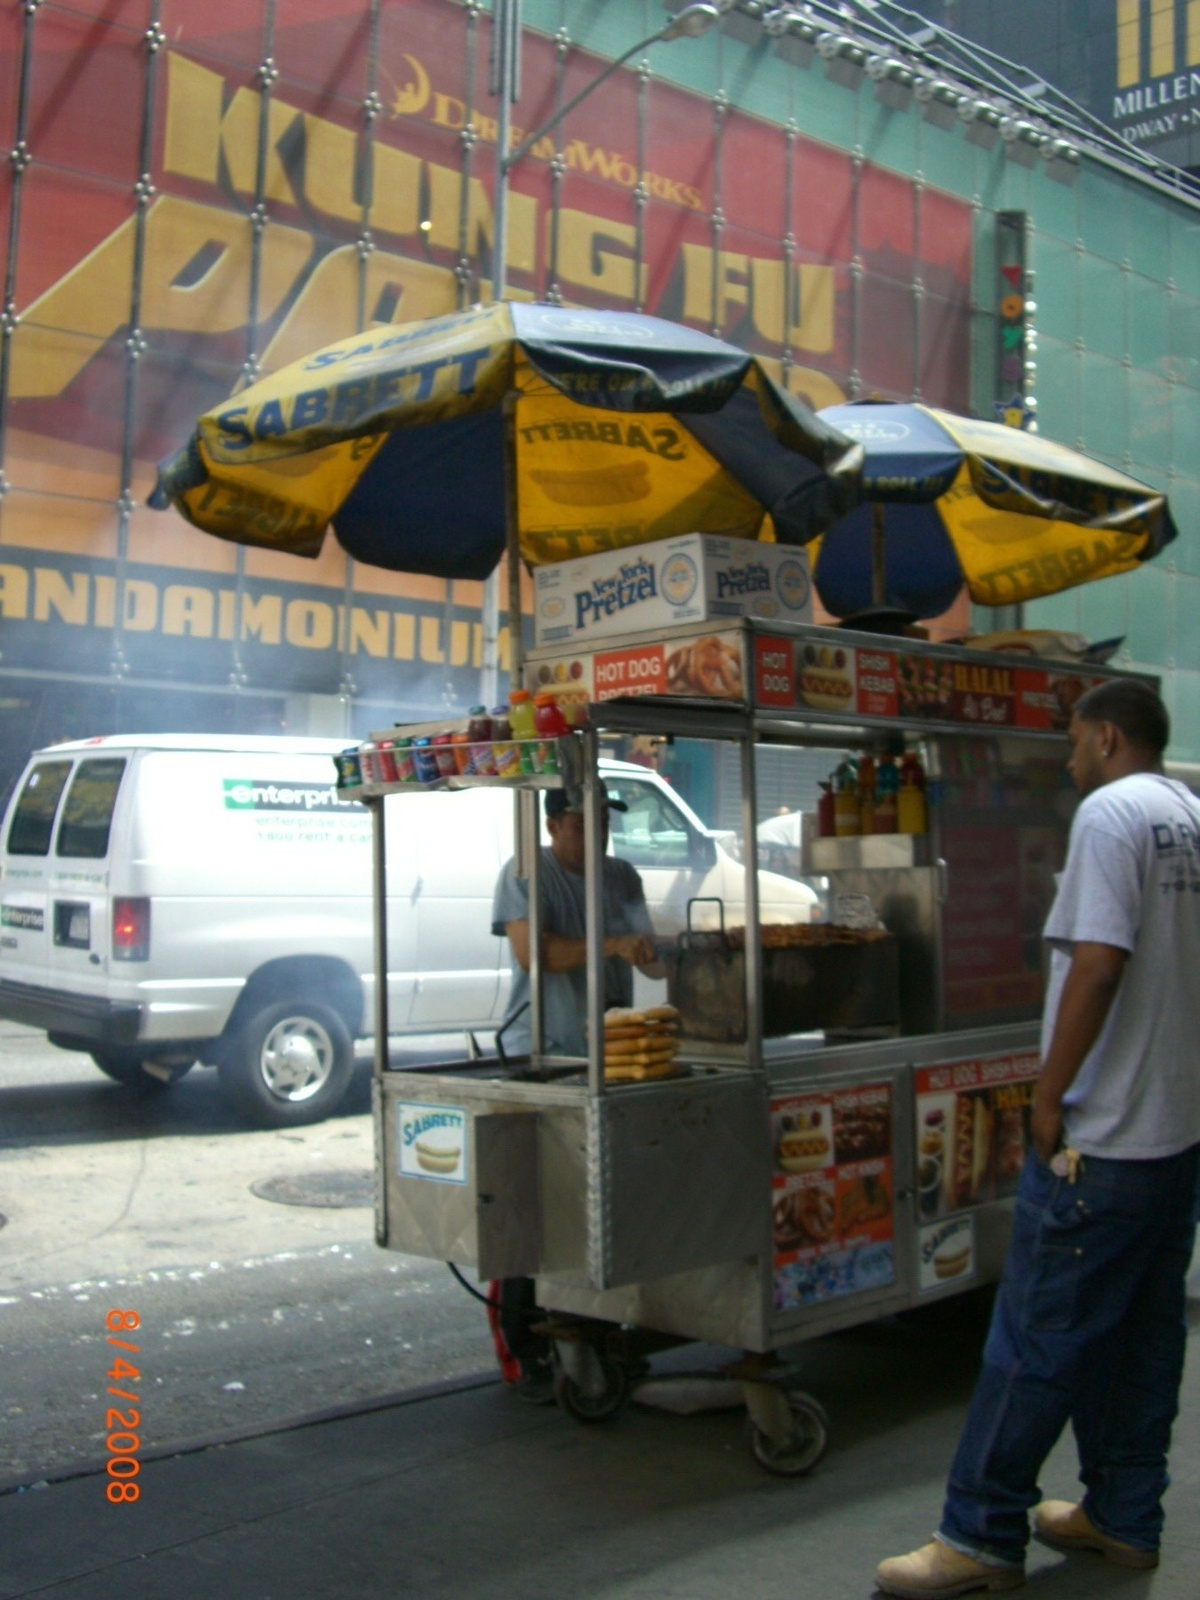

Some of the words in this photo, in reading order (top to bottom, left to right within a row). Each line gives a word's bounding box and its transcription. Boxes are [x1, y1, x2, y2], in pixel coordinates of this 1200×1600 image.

[163, 50, 648, 301] KUNG
[681, 241, 836, 354] FU
[216, 346, 490, 451] SABRETT
[574, 565, 657, 629] Pretzel
[596, 661, 625, 683] HOT
[629, 656, 661, 679] DOG
[762, 651, 787, 669] HOT
[763, 675, 789, 692] DOG
[859, 675, 896, 693] KEBAB
[402, 1113, 462, 1147] SABRETT
